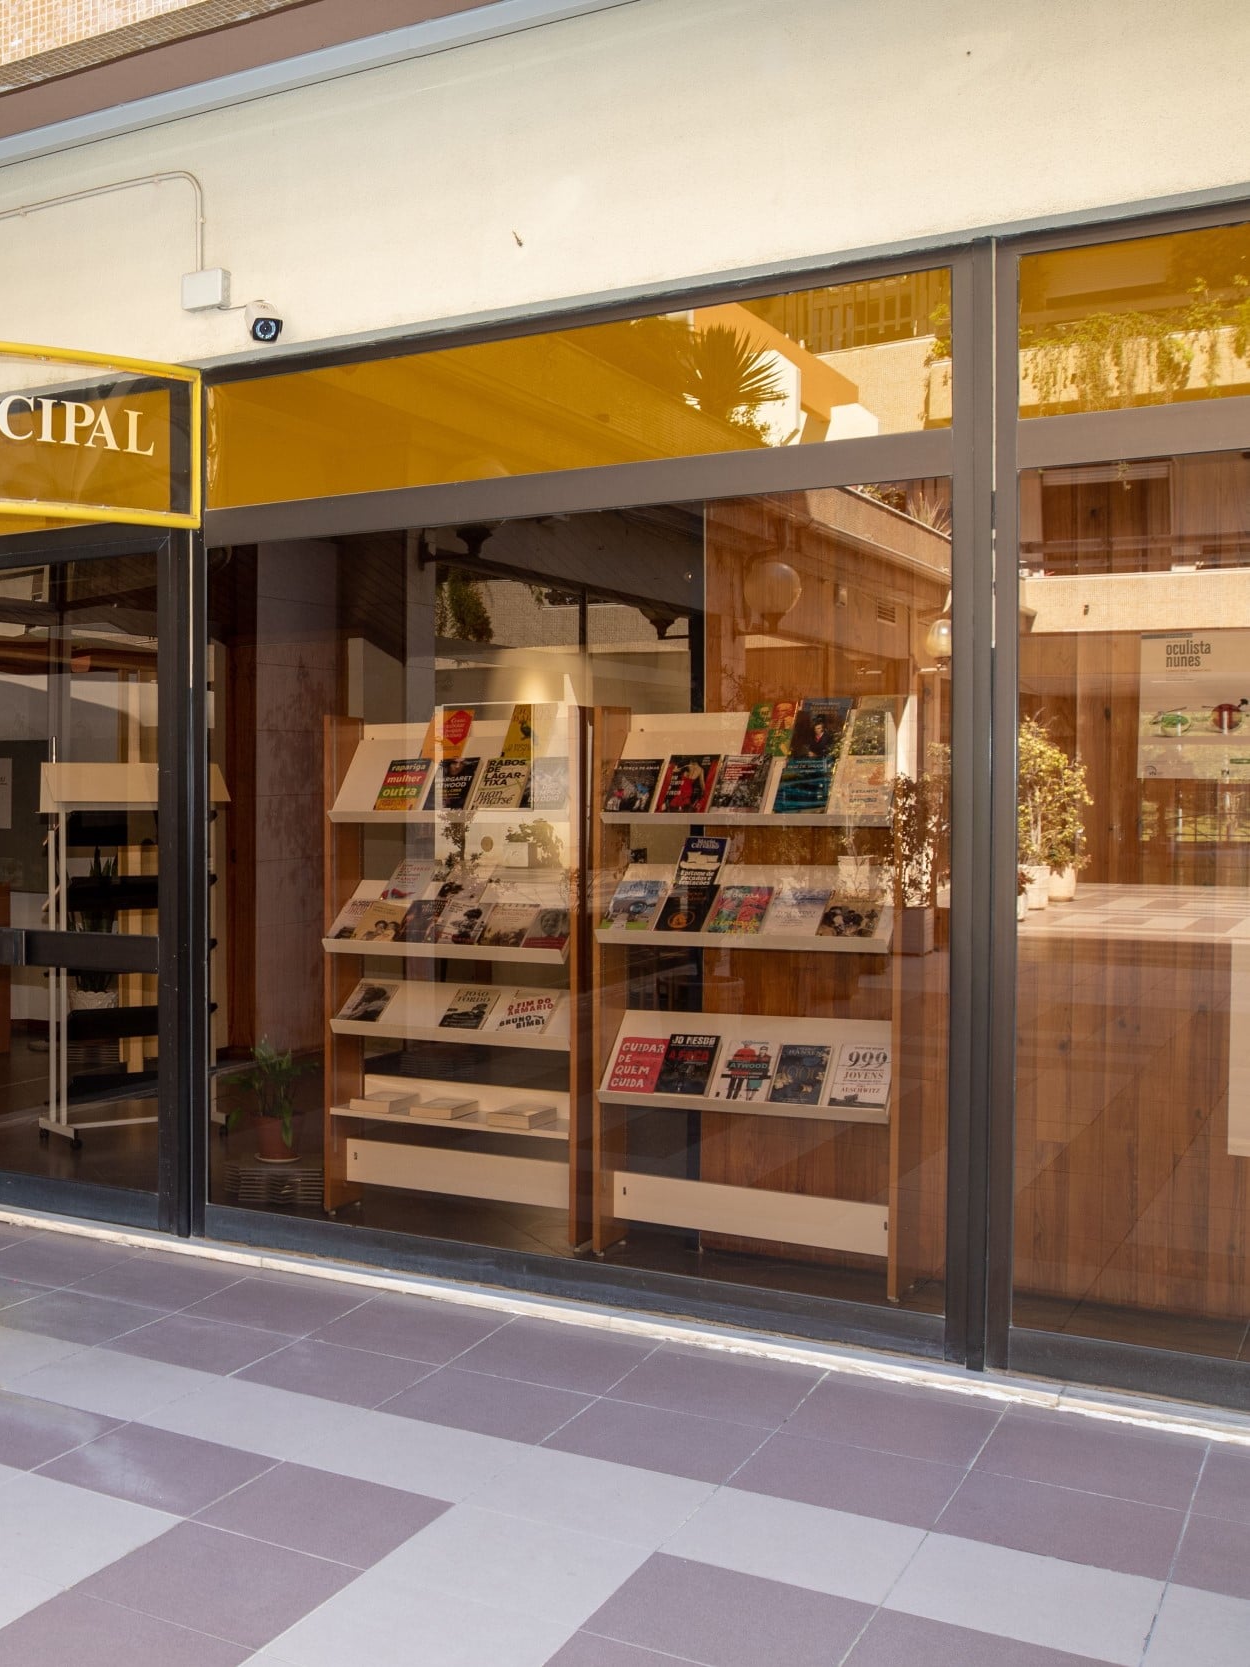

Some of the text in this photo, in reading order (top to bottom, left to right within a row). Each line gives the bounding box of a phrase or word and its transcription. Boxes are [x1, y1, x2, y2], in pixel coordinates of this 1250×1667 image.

[1166, 640, 1211, 656] oculista
[1166, 655, 1201, 667] nunes
[387, 774, 423, 783] mulher
[382, 786, 417, 797] outra
[517, 1000, 534, 1008] FIM
[499, 1015, 532, 1026] BRUNO
[516, 1019, 545, 1029] BIMBI
[672, 1036, 684, 1044] JO
[622, 1042, 665, 1053] CUIDAR
[618, 1054, 632, 1063] DE
[847, 1051, 888, 1068] 999
[614, 1065, 650, 1075] QUEM
[845, 1071, 884, 1080] JOVENS
[611, 1077, 644, 1088] CUIDA
